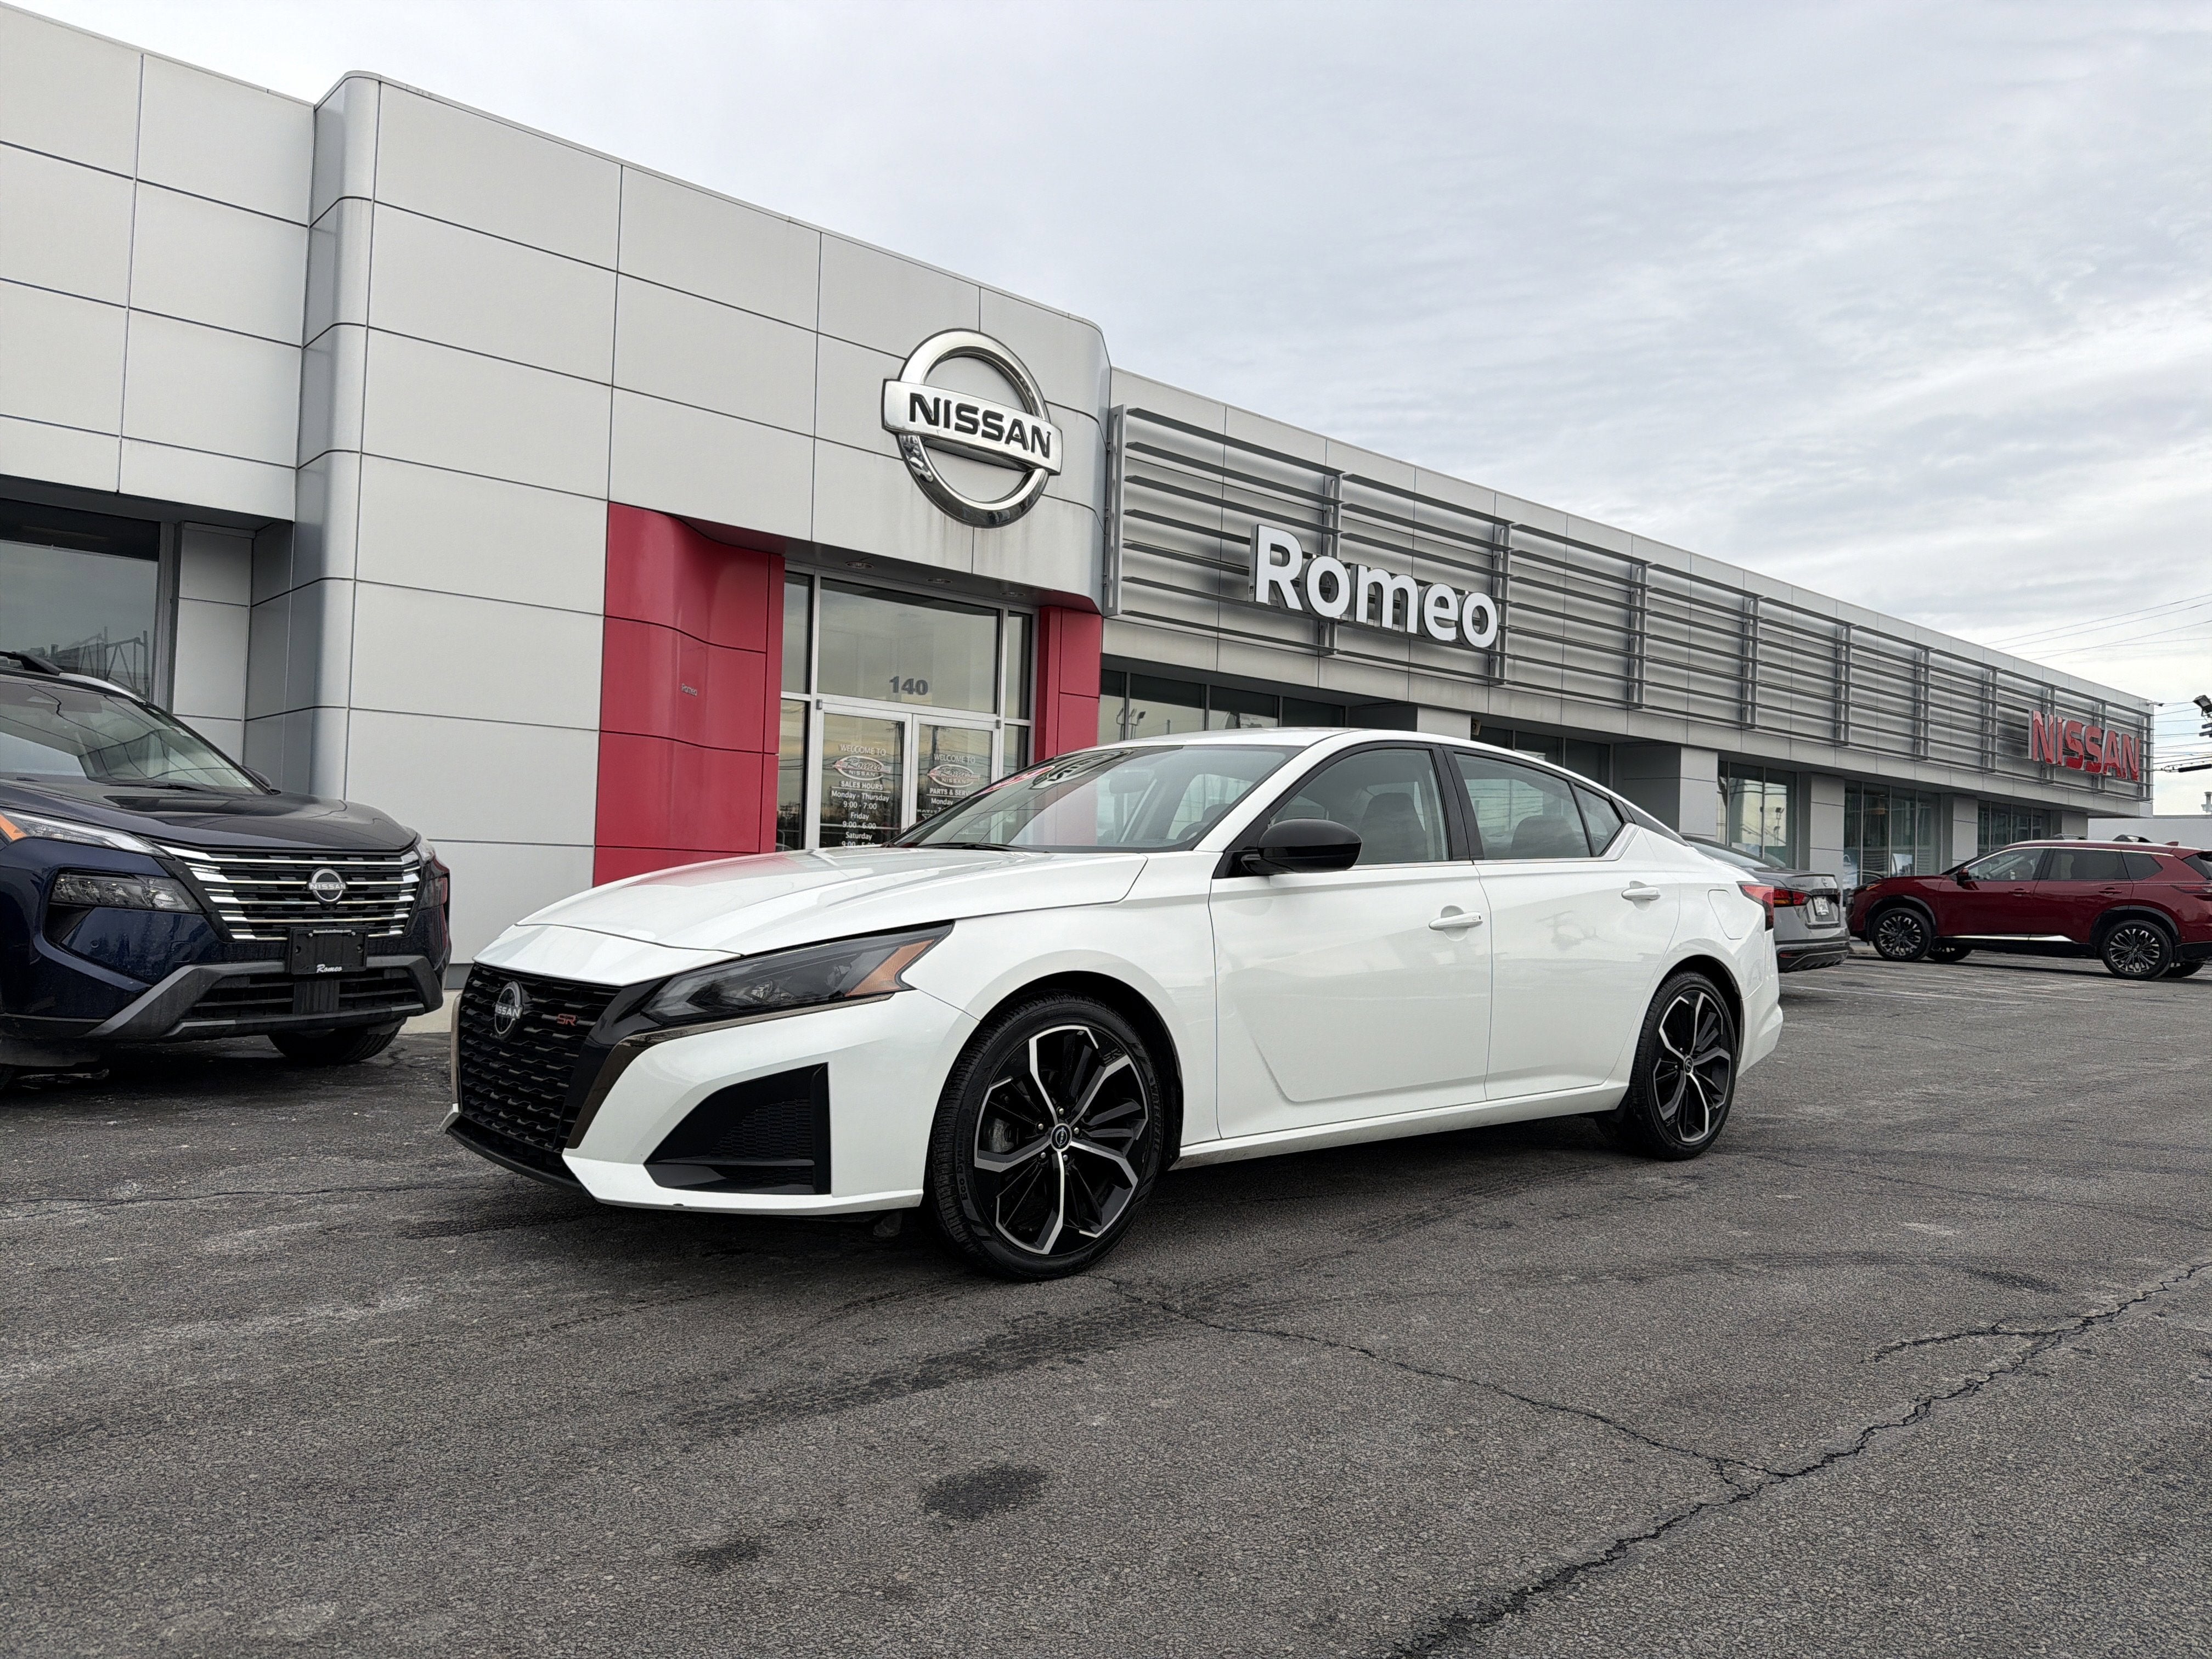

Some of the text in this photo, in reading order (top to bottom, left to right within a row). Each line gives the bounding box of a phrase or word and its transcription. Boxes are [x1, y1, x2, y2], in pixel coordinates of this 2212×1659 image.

[909, 392, 1052, 460] NISSAN
[1249, 523, 1498, 648] Romeo
[681, 683, 698, 696] Romeo
[889, 675, 929, 696] 140
[840, 744, 887, 756] WELCOME TO
[2032, 709, 2140, 781] NISSAN
[934, 754, 966, 763] WELCOME
[840, 780, 884, 791] SALES HOURS
[831, 790, 856, 800] Monday
[861, 792, 890, 803] Thursday
[850, 812, 870, 821] Friday
[845, 832, 873, 840] Saturday
[316, 964, 343, 973] Romeo
[495, 1005, 521, 1018] SSAN
[557, 1013, 577, 1026] SR
